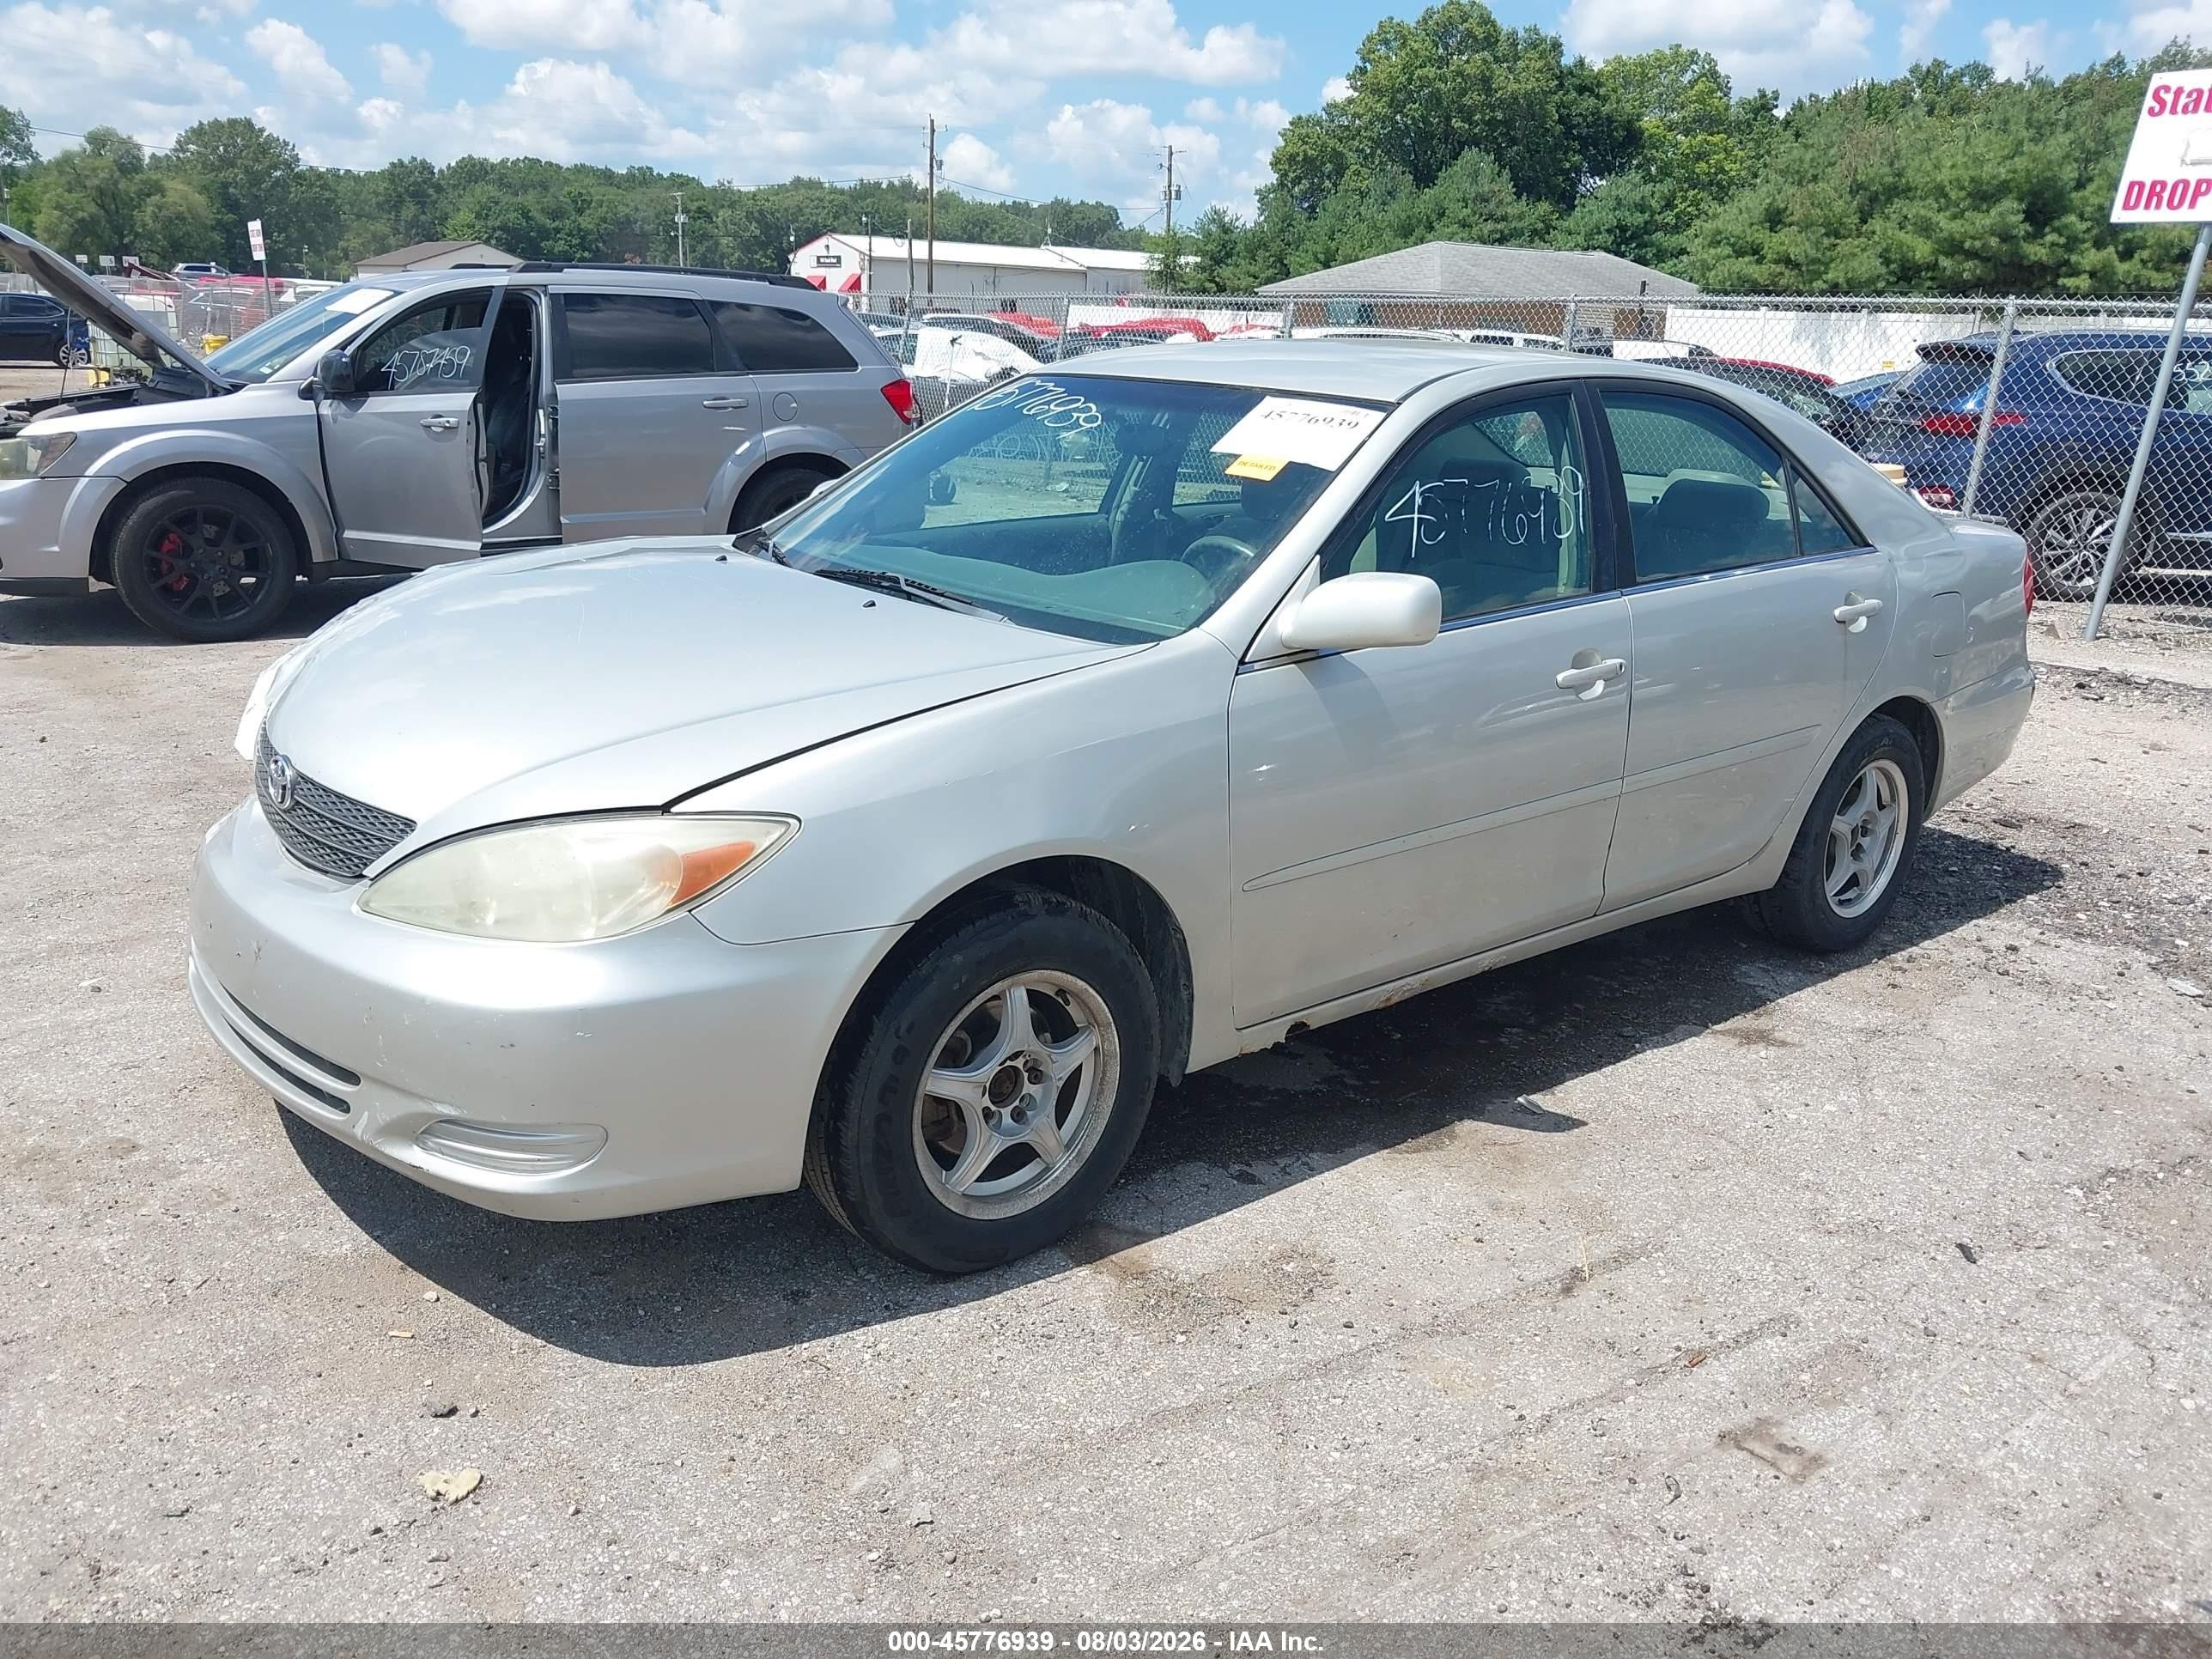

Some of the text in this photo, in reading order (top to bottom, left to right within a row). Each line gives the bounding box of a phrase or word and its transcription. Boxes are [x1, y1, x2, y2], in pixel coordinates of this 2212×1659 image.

[2148, 84, 2212, 118] Stat
[2122, 178, 2212, 211] DROP
[380, 345, 471, 391] 45787459
[1260, 410, 1360, 430] 45776939
[1237, 459, 1277, 471] DETAILED
